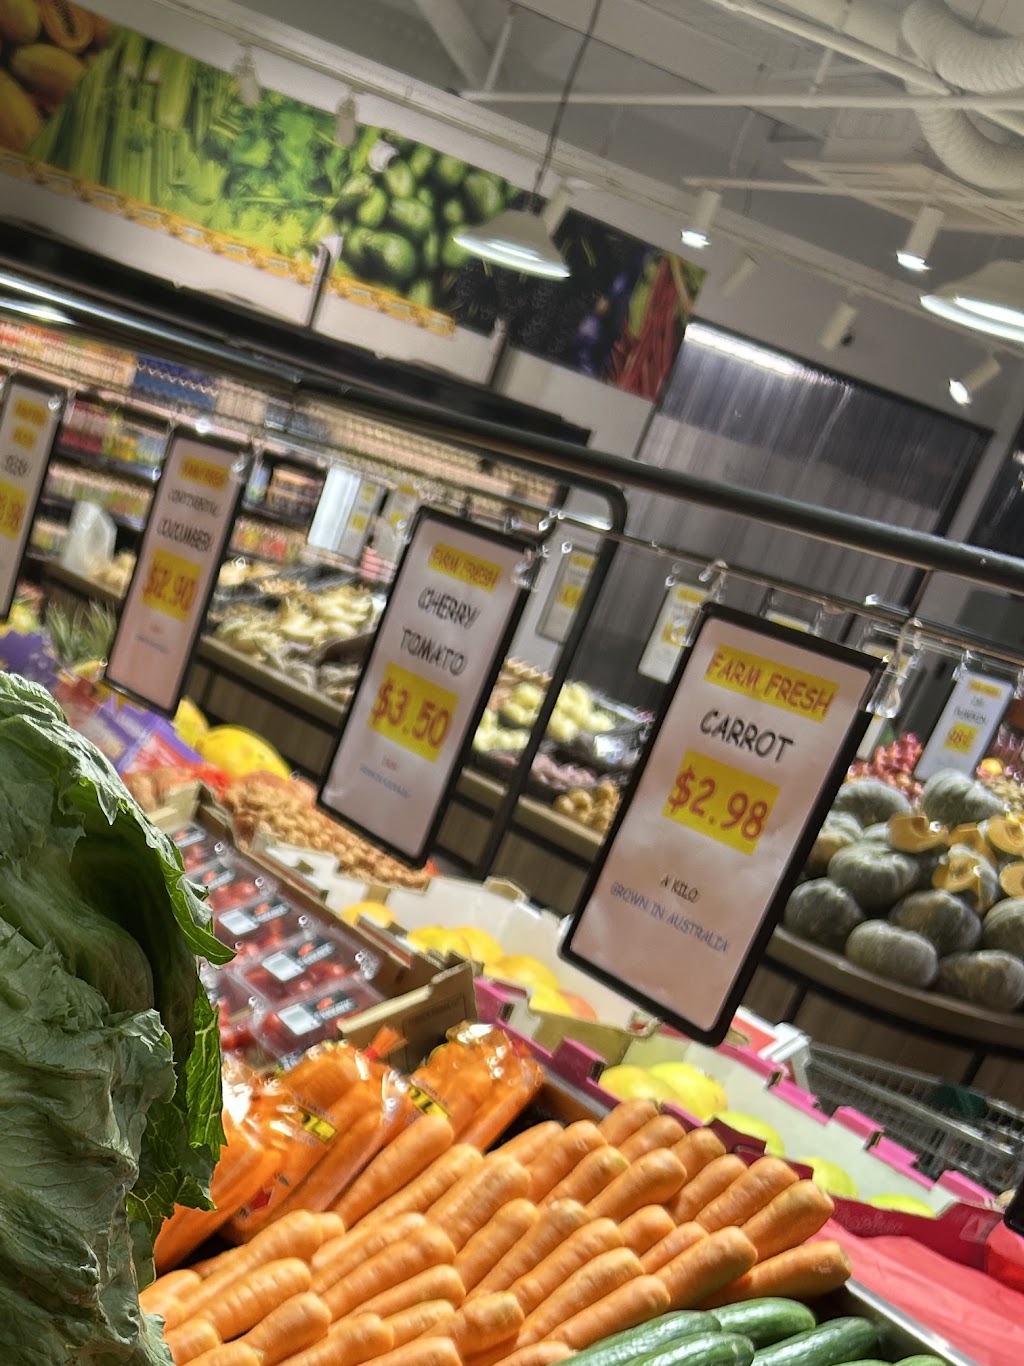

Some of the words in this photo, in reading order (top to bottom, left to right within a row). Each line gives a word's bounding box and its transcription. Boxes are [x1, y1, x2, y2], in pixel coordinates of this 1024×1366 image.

[418, 585, 480, 629] CHERRY
[401, 626, 467, 676] TOMATO
[372, 678, 452, 748] $3.50
[706, 653, 760, 690] FARM
[764, 674, 835, 717] FRESH
[699, 709, 794, 763] CARROT
[668, 764, 769, 842] $2.98
[610, 881, 649, 911] GROWN
[651, 902, 666, 920] IN
[666, 912, 729, 953] AUSTRALIA
[671, 877, 700, 904] KILO
